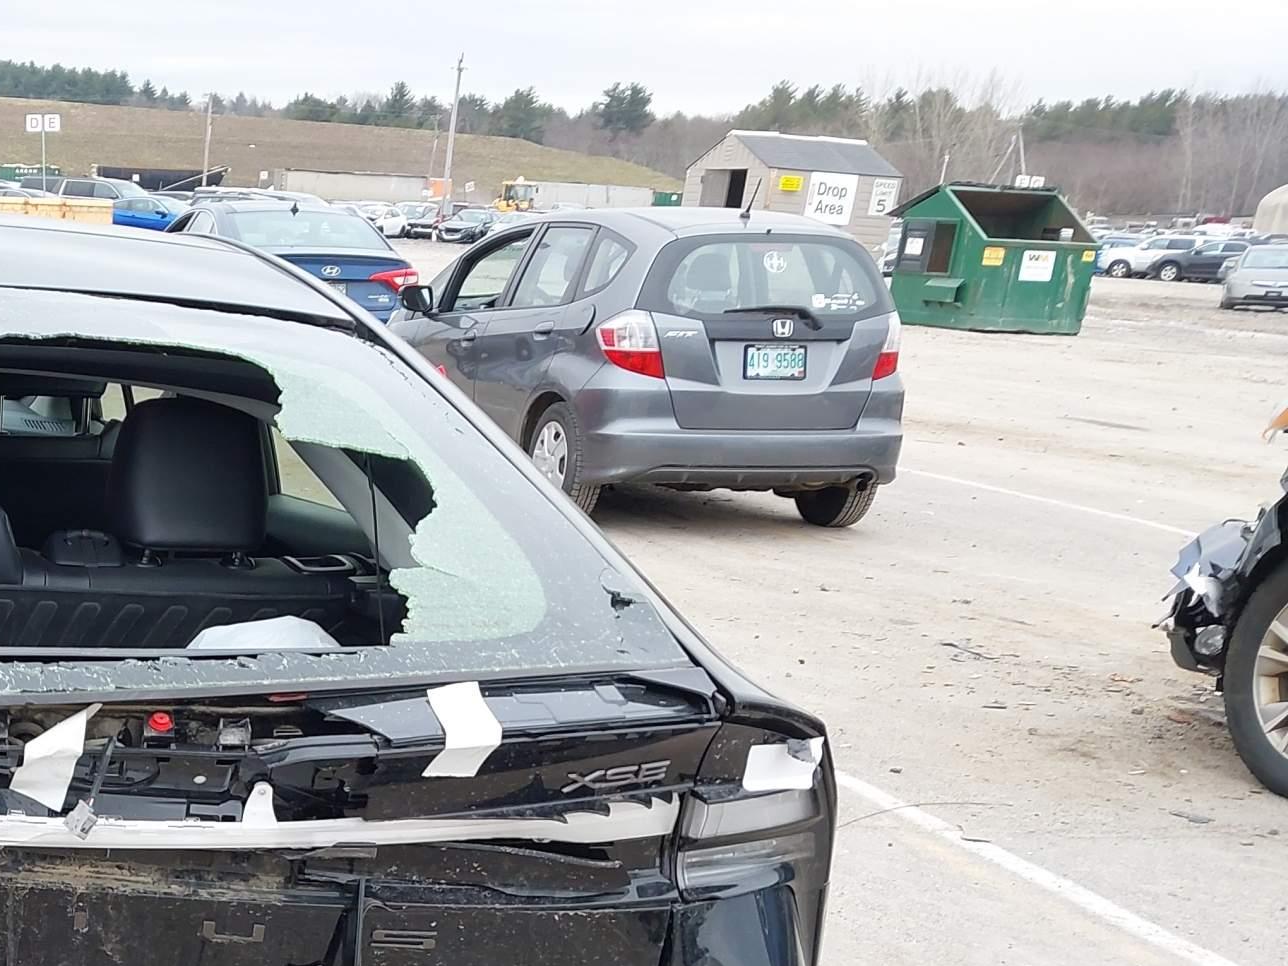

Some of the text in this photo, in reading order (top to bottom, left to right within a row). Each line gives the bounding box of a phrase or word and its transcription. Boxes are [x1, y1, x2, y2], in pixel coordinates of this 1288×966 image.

[30, 117, 39, 129] D
[48, 117, 57, 129] E
[817, 181, 848, 200] Drop
[874, 181, 896, 190] SPEED
[814, 199, 844, 215] Area
[875, 199, 886, 213] 5
[749, 352, 769, 369] 419
[561, 759, 672, 793] XSE
